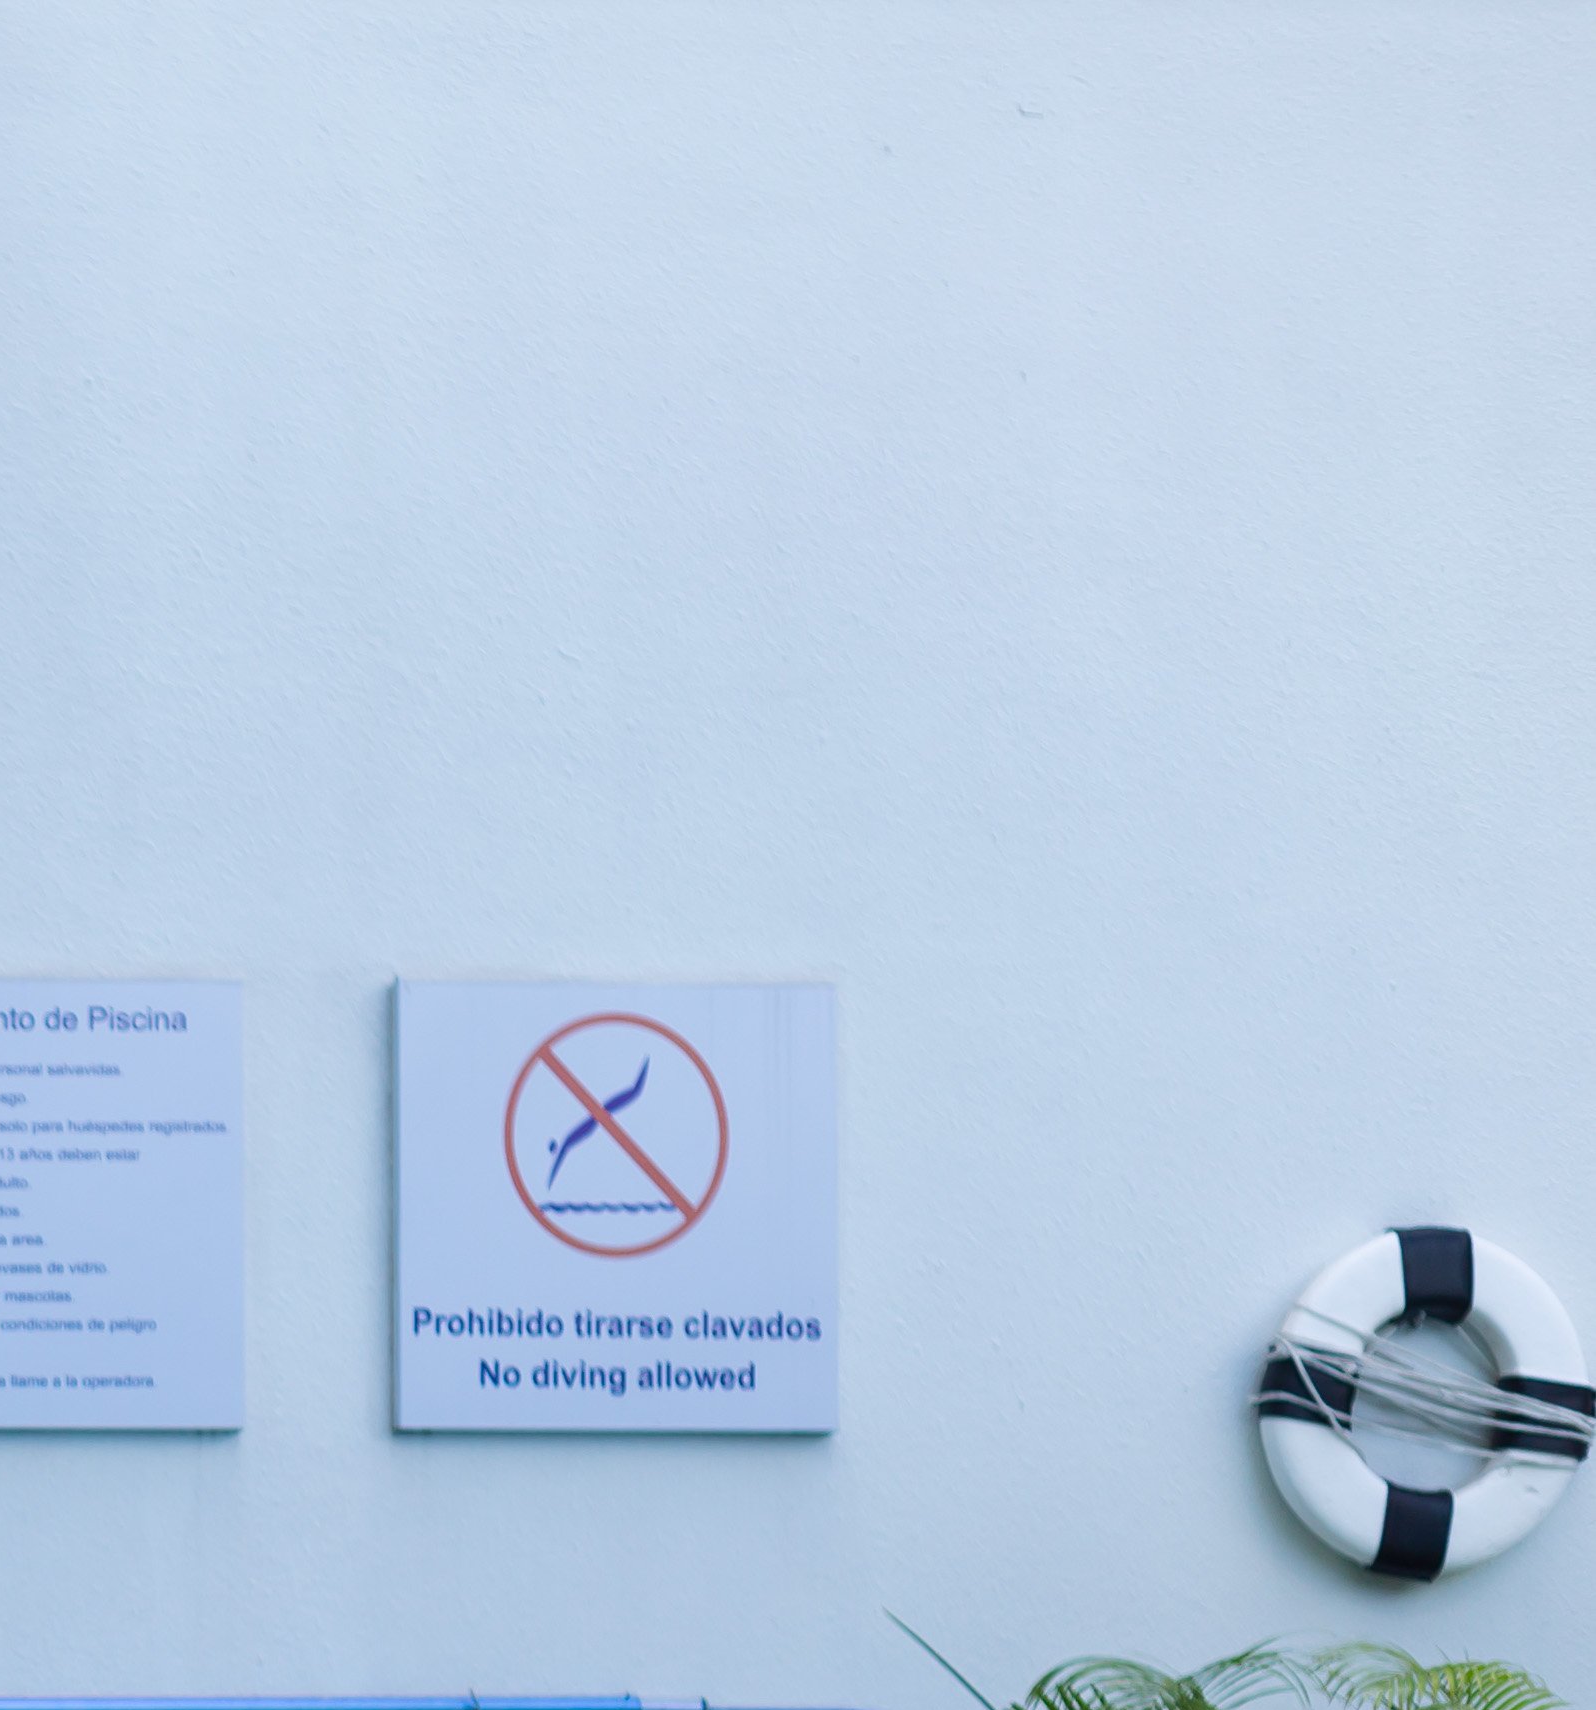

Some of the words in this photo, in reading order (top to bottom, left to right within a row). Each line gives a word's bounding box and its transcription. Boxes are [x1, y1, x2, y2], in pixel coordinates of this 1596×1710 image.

[44, 1007, 78, 1031] de
[88, 1006, 187, 1032] Piscina
[413, 1307, 564, 1337] Prohibido
[574, 1310, 673, 1338] tirarse
[684, 1311, 821, 1340] clavados
[480, 1359, 521, 1388] No
[531, 1360, 626, 1396] diving
[638, 1361, 755, 1390] allowed
